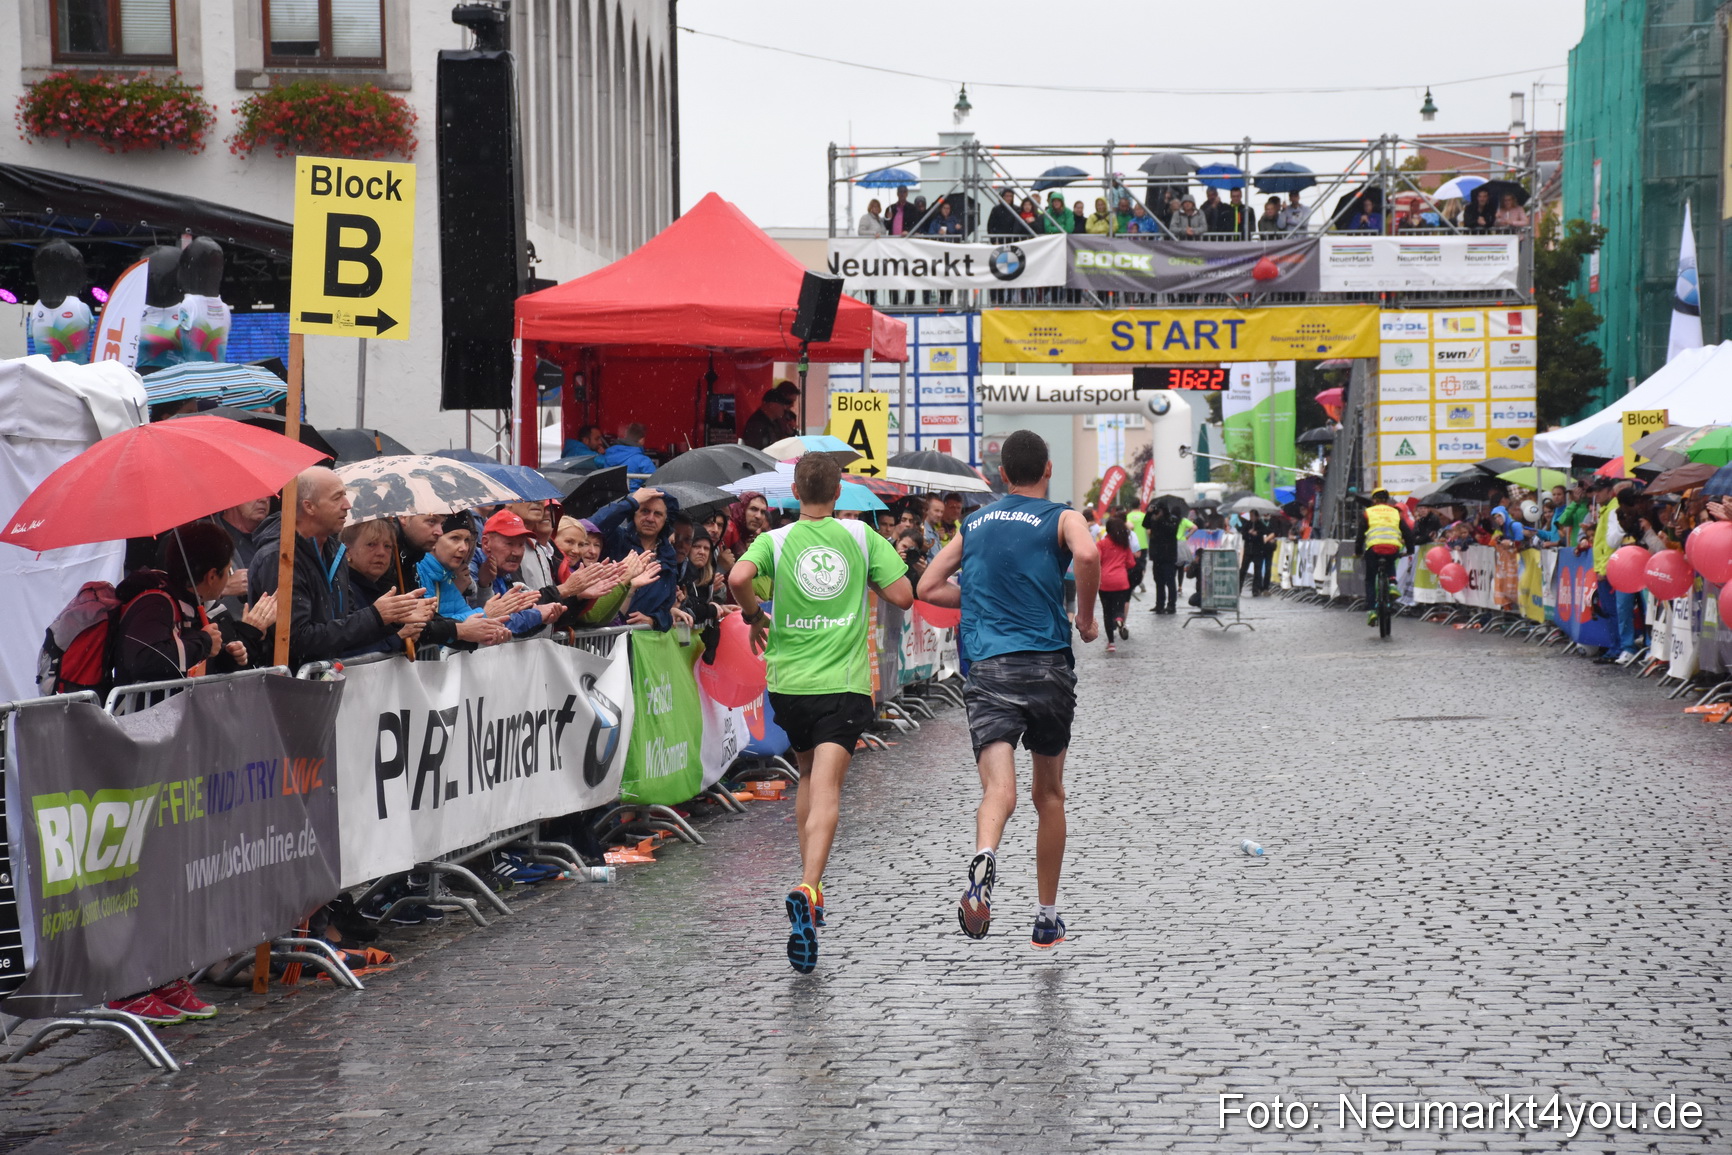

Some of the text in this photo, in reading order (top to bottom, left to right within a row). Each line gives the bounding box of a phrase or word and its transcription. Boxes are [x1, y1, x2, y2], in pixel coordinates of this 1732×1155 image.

[310, 164, 403, 202] Block
[322, 211, 384, 298] B
[827, 251, 975, 278] Neumarkt
[1075, 250, 1150, 269] BOCK
[1329, 255, 1375, 264] NeuerMarkt
[1396, 254, 1442, 263] NeuerMarkt
[1464, 254, 1510, 263] NeuerMarkt
[1110, 318, 1247, 351] START
[1437, 351, 1467, 360] swn
[1167, 368, 1225, 390] 36:22
[837, 395, 882, 412] Block
[1036, 384, 1141, 406] Laufsport
[1627, 412, 1664, 426] Block
[846, 418, 875, 460] A
[1100, 469, 1123, 505] REWE
[967, 510, 1043, 533] TSV PAVELSBACH
[810, 552, 836, 573] SC
[101, 883, 140, 918] concepts
